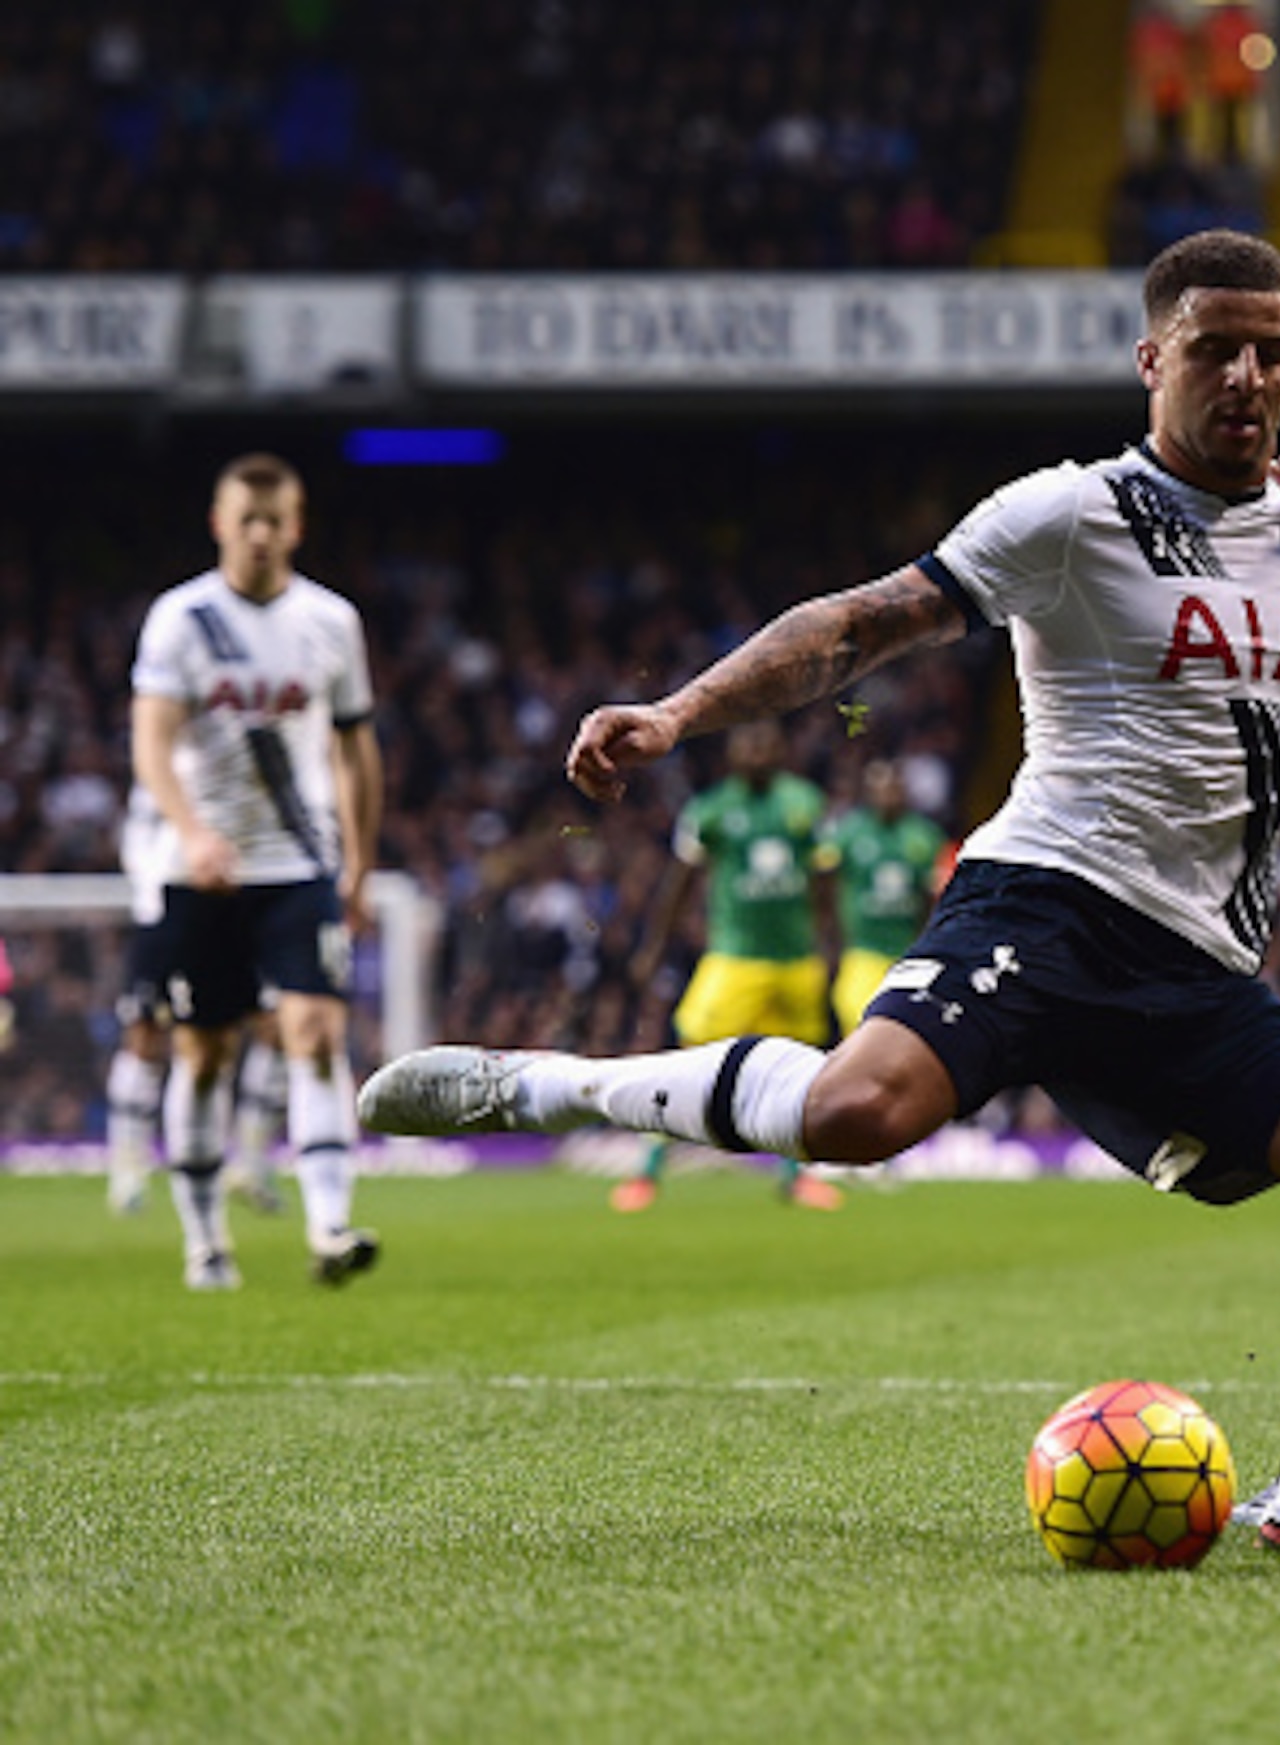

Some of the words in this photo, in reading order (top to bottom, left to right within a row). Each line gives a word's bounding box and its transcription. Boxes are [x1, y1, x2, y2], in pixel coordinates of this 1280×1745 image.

[472, 292, 578, 364] TO
[938, 290, 1041, 362] TO
[203, 676, 310, 714] AIA
